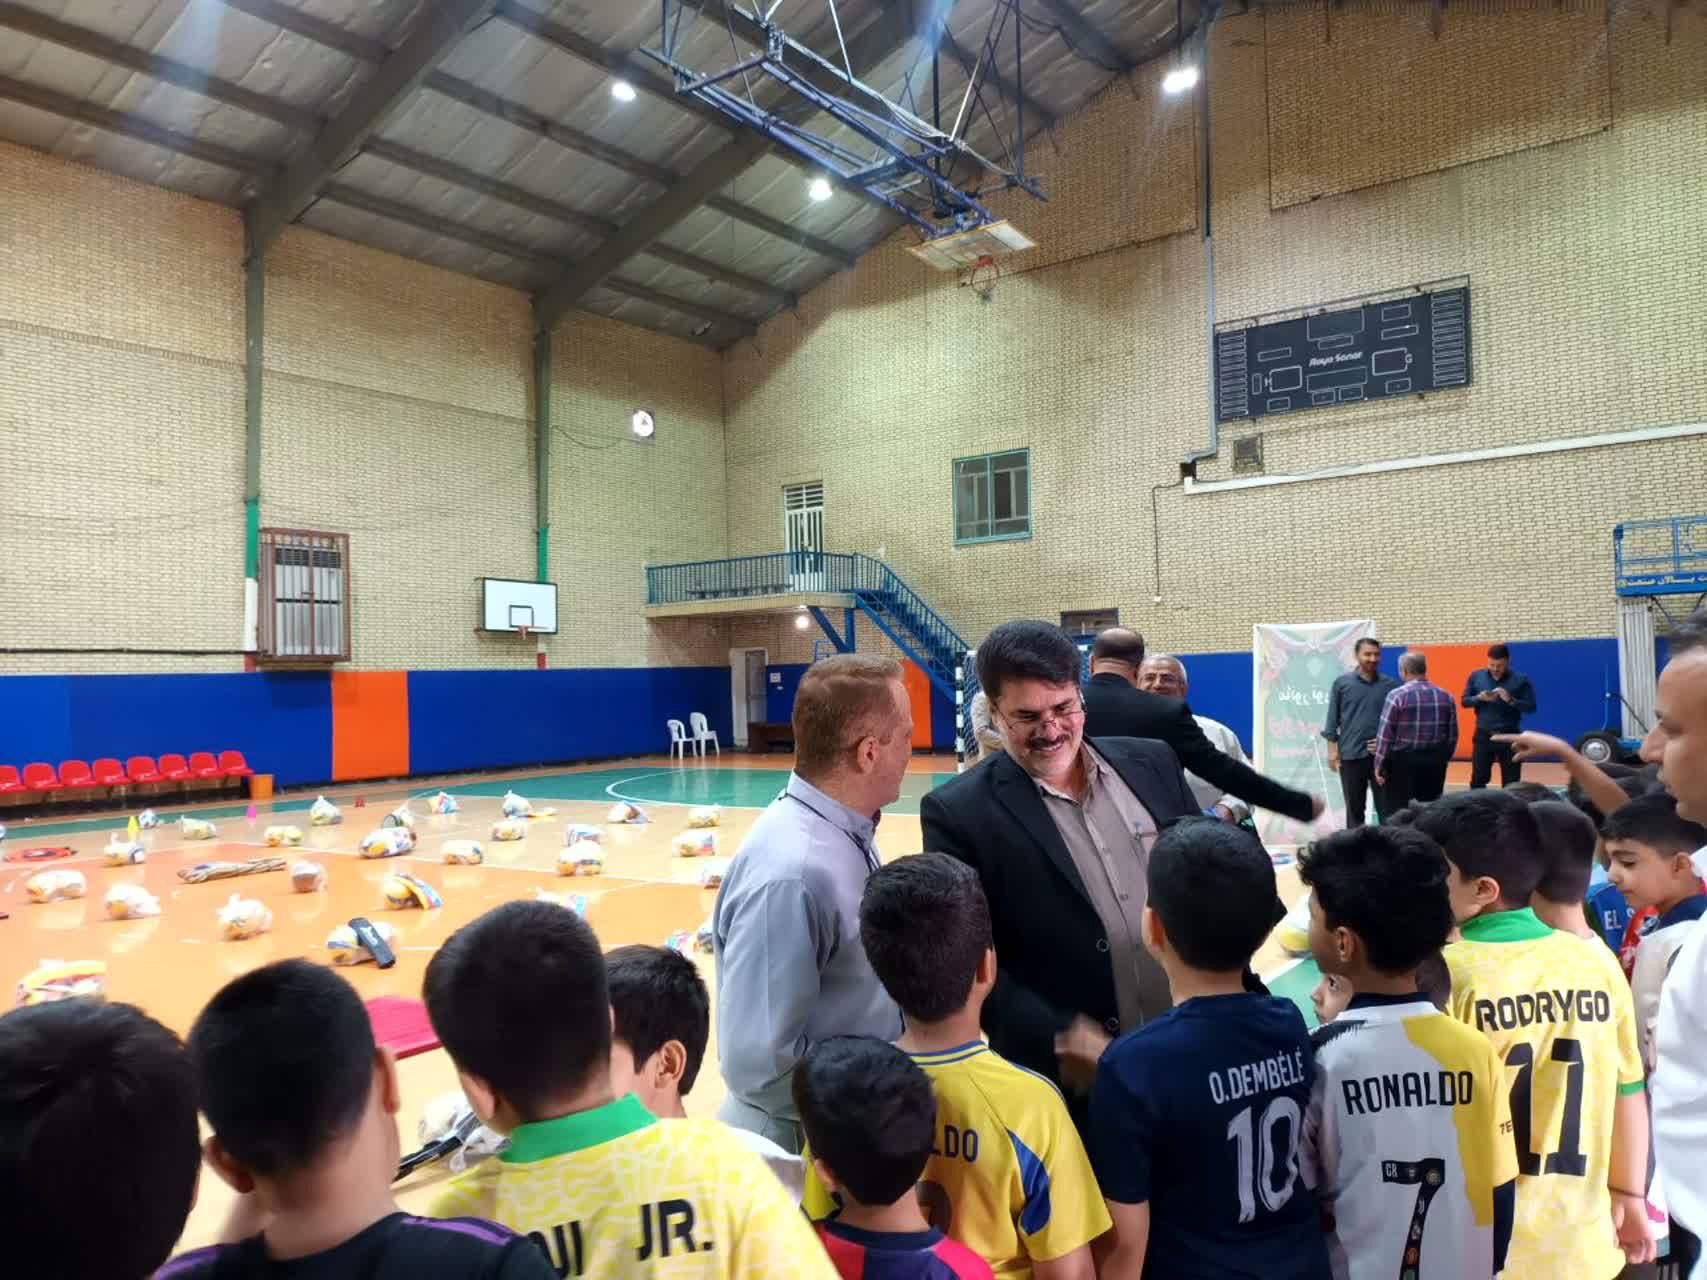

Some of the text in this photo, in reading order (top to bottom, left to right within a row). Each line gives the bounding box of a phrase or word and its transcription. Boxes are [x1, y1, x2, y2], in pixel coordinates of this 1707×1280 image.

[1603, 910, 1622, 931] EL
[1475, 989, 1610, 1033] RODRYGO
[1208, 1047, 1305, 1105] O.DEMBÉLÉ
[1342, 1070, 1473, 1116] RONALDO
[1504, 1038, 1588, 1177] 11
[934, 1124, 979, 1163] DO
[1226, 1096, 1301, 1224] 10
[636, 1198, 714, 1262] JR.
[1381, 1158, 1445, 1280] 7
